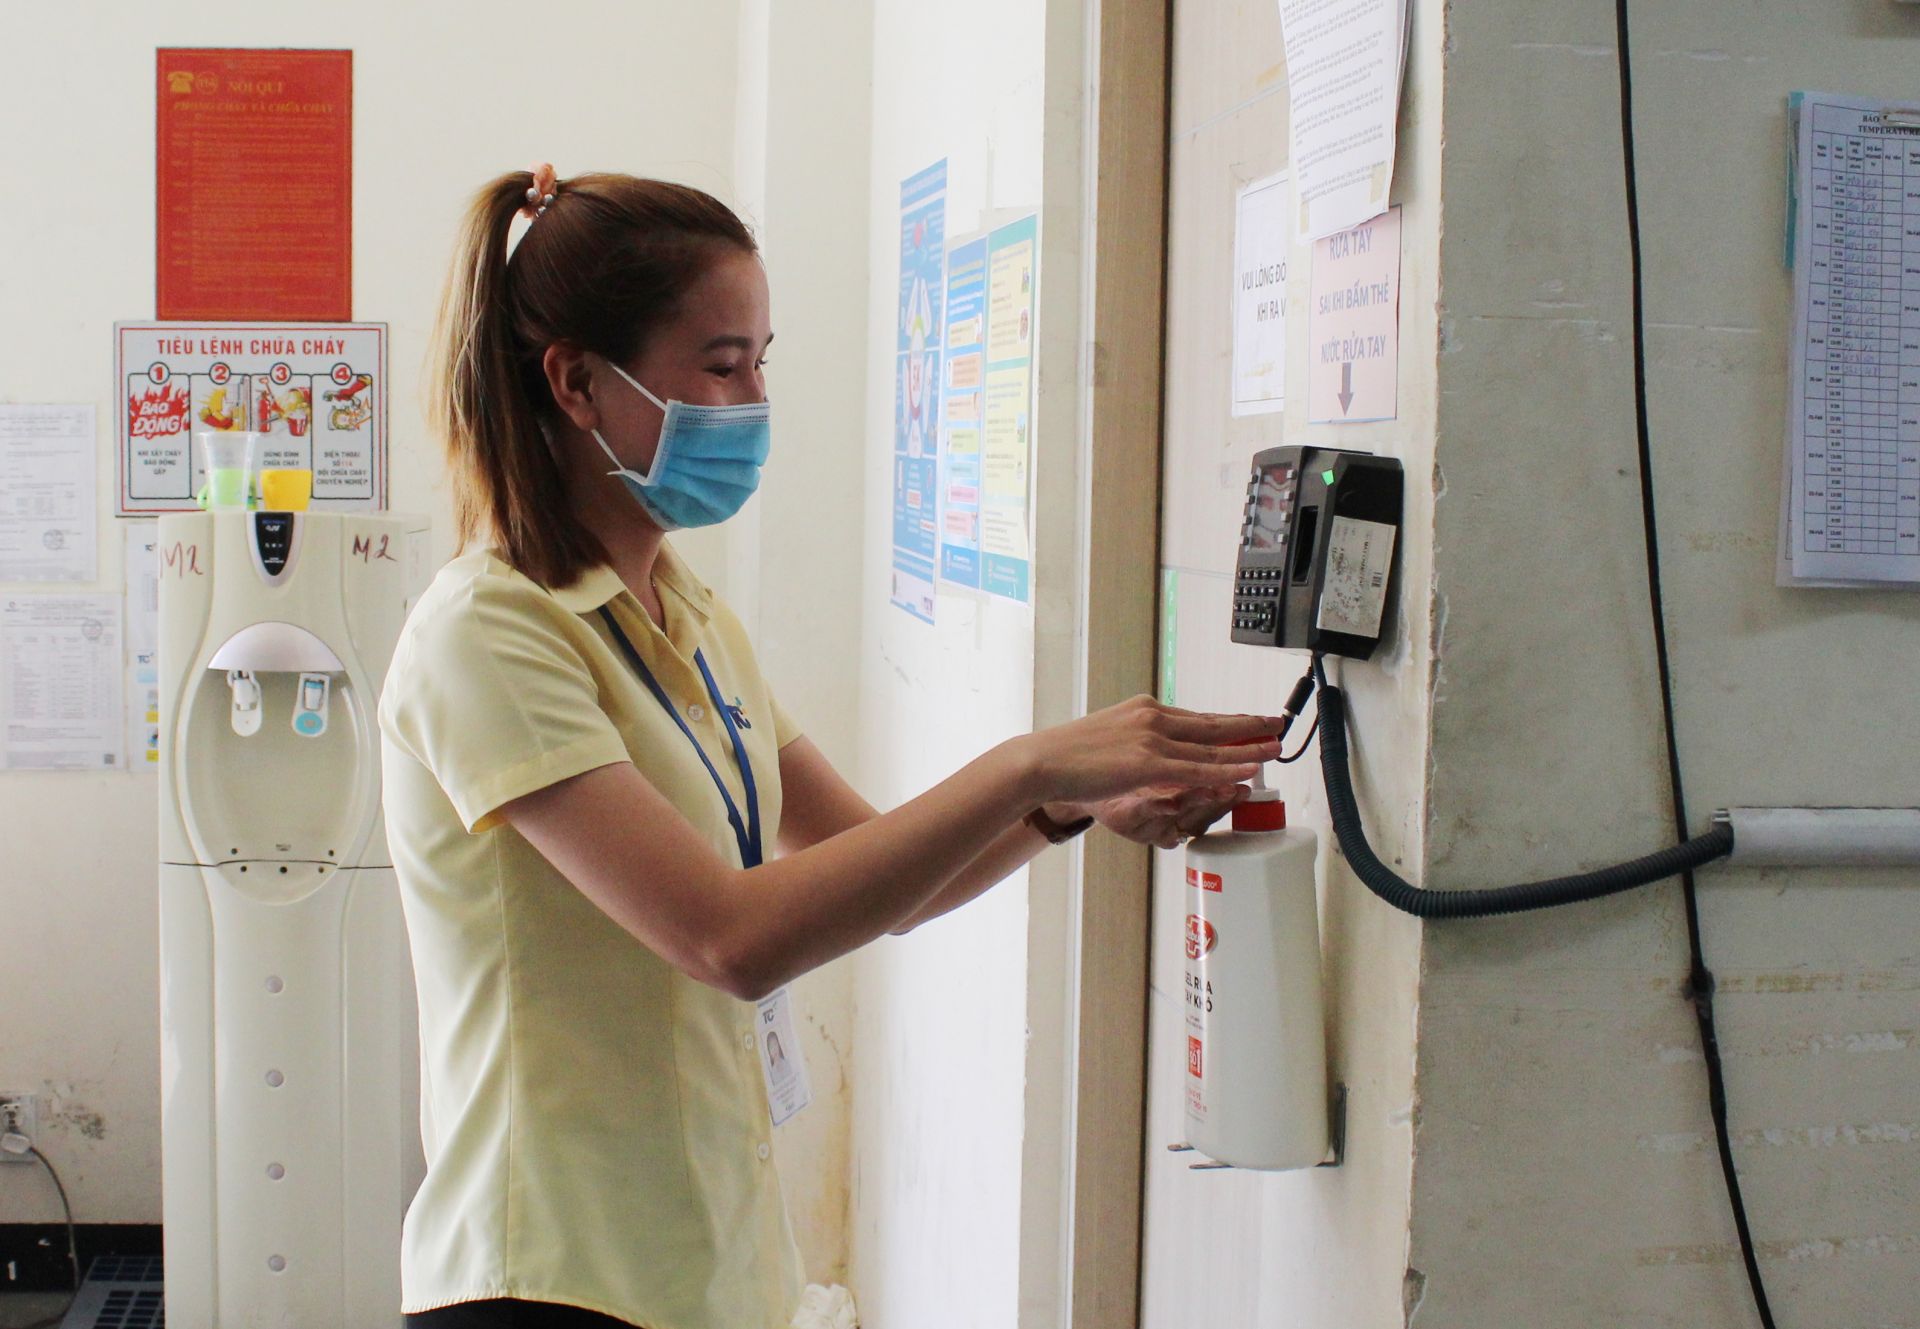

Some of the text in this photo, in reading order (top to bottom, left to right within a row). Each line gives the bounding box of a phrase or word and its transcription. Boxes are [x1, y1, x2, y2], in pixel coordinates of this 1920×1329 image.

[1352, 227, 1372, 255] TAY
[1270, 299, 1279, 320] RA
[1332, 290, 1344, 312] KHI
[157, 335, 345, 358] TIÊU LỆNH CHỮA CHÁY
[1367, 335, 1386, 358] TAY
[153, 367, 163, 380] 1
[214, 366, 226, 380] 2
[276, 366, 287, 380] 3
[334, 367, 350, 380] 4
